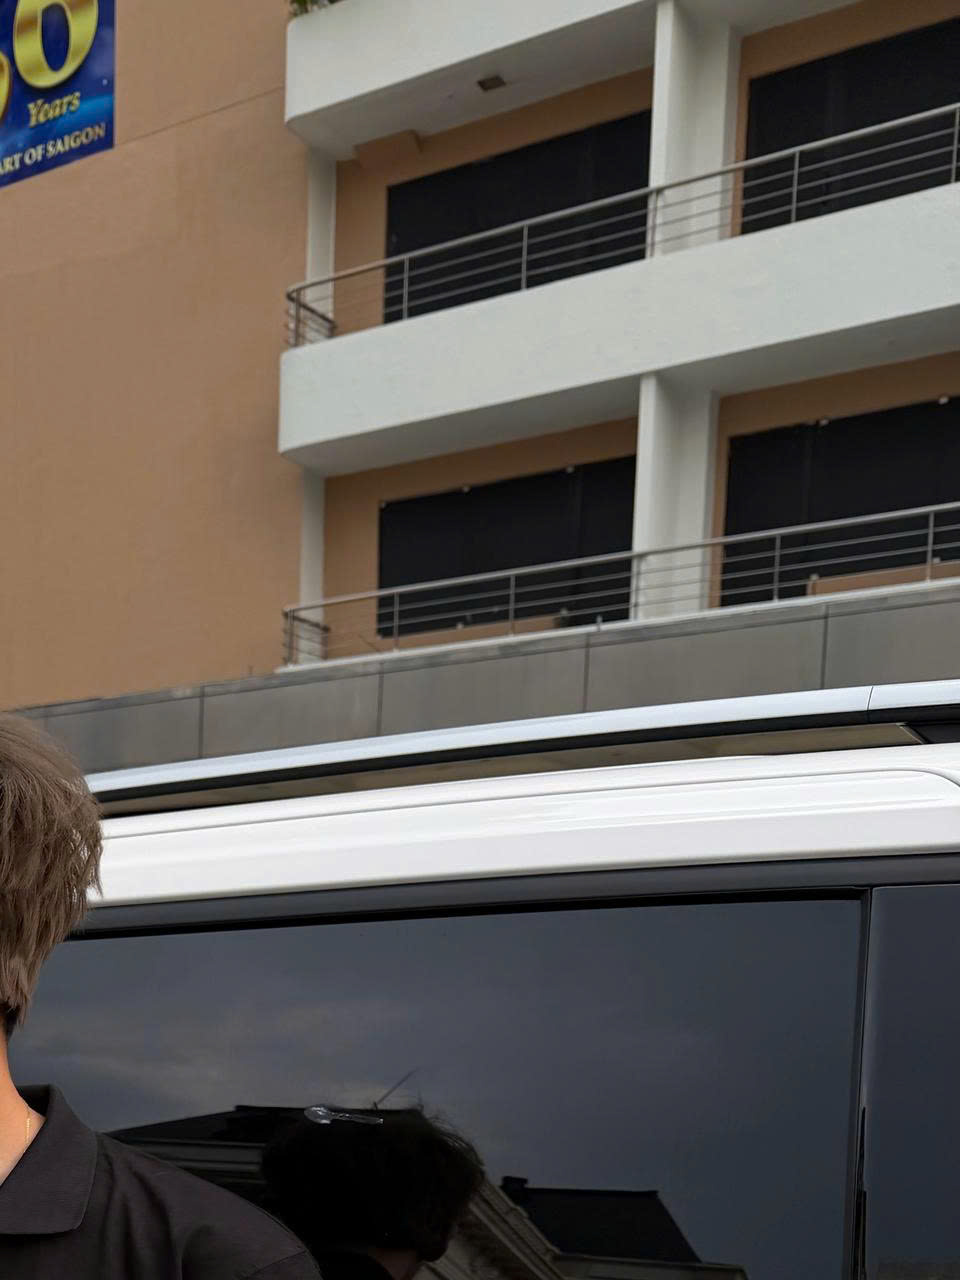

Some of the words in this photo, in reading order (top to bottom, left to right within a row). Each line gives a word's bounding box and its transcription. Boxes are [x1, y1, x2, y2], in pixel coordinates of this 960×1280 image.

[28, 91, 81, 128] Years
[24, 143, 46, 166] OF
[46, 122, 106, 159] SAIGON
